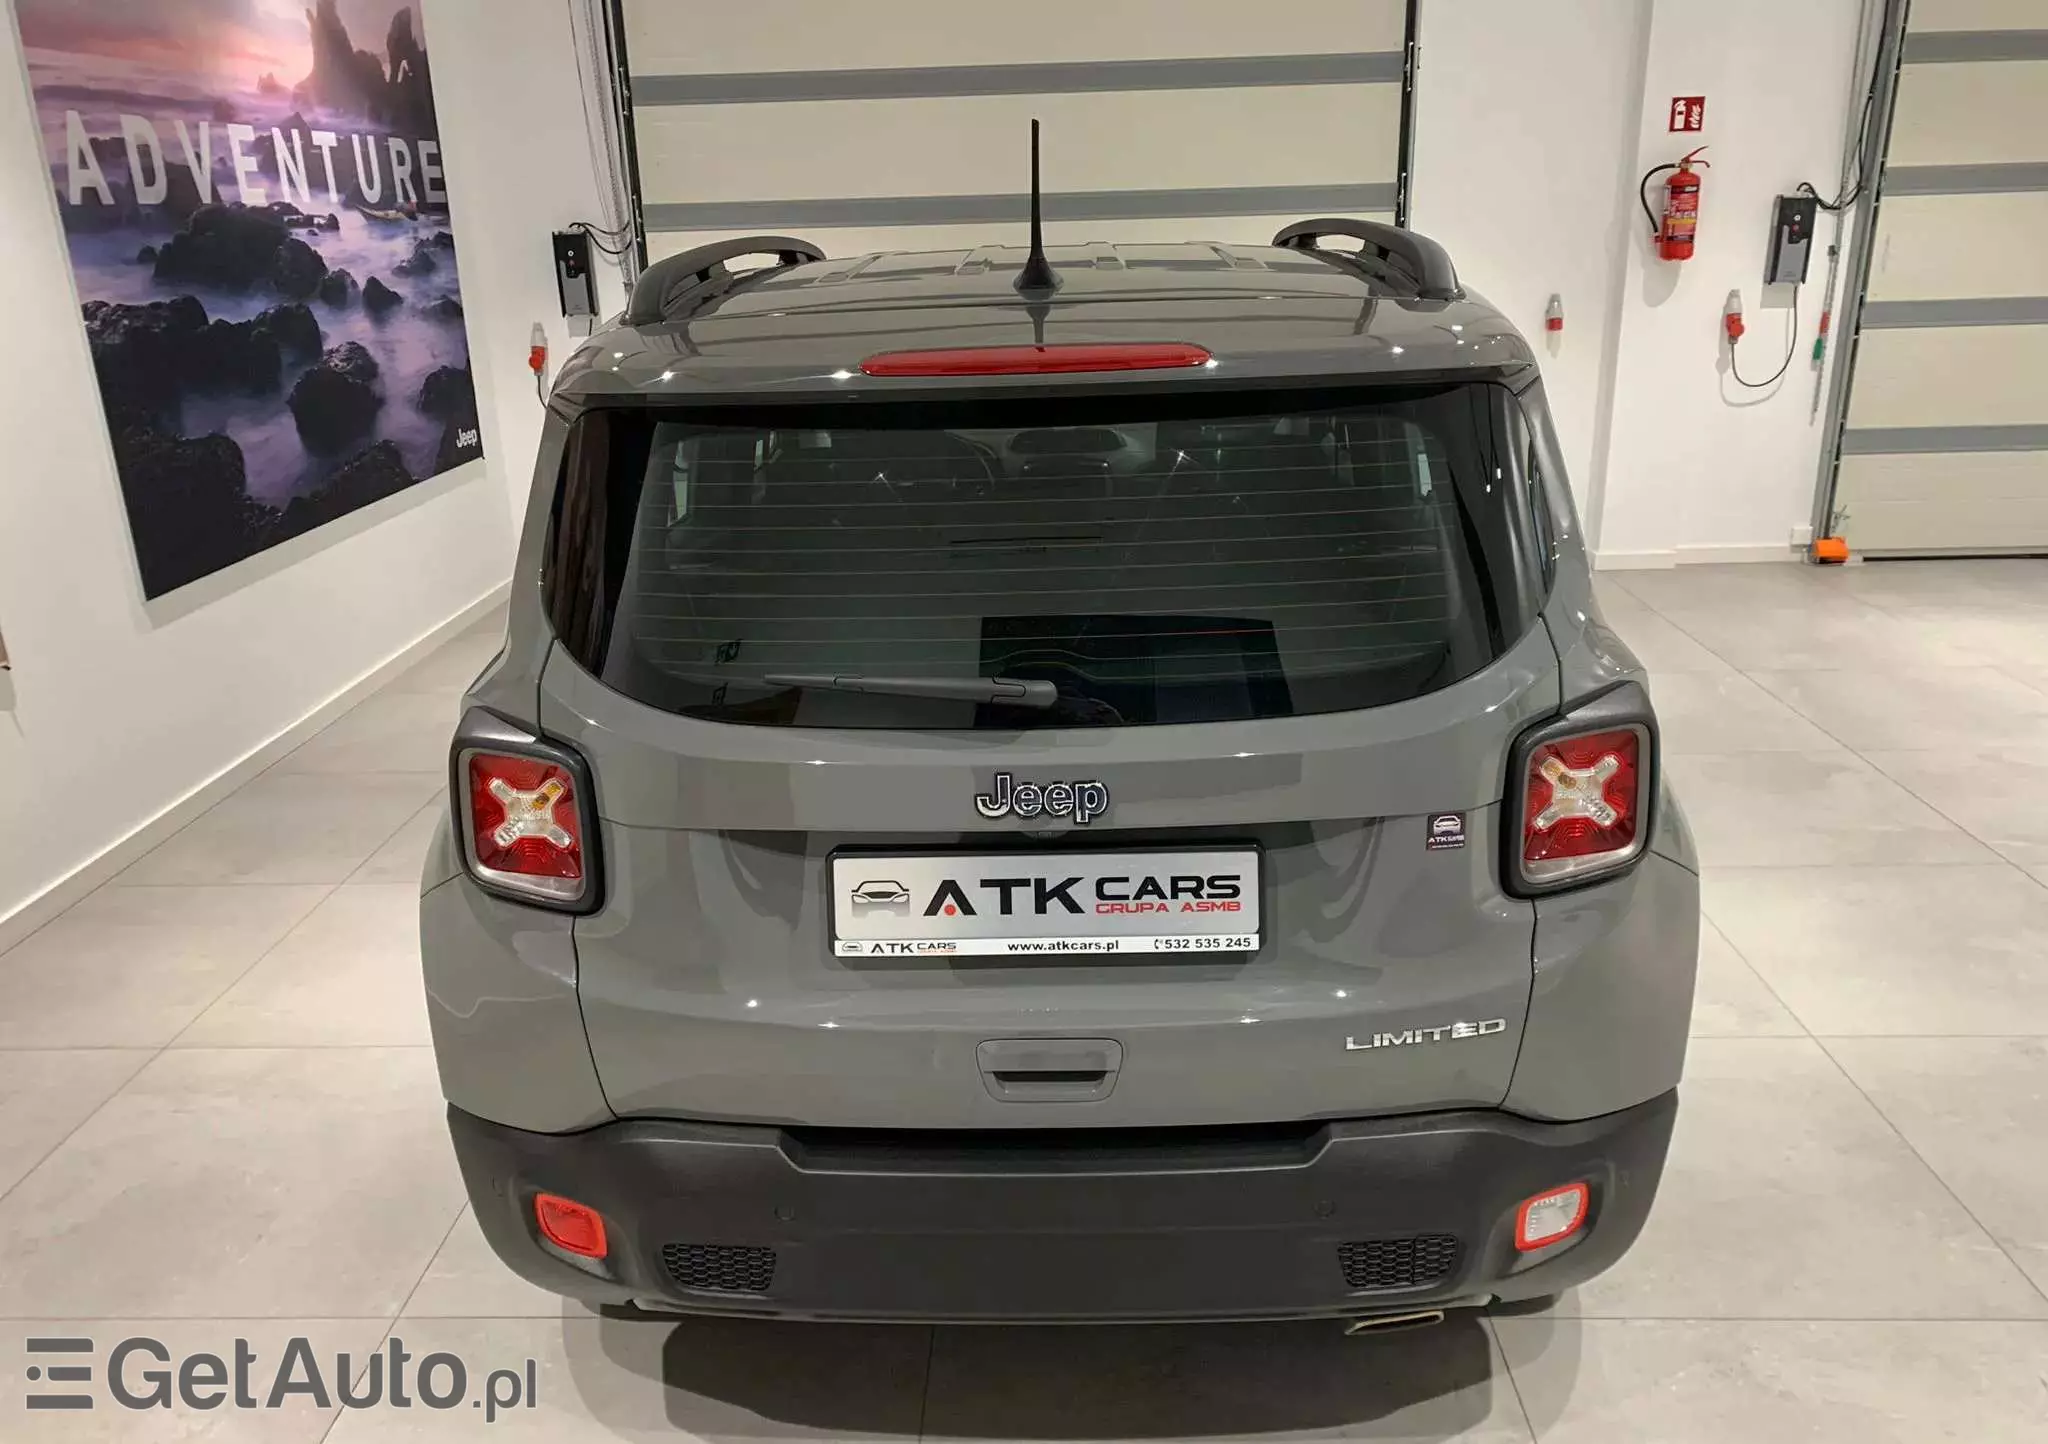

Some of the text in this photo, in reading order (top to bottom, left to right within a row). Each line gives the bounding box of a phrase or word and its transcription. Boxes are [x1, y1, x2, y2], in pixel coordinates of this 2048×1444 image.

[65, 109, 447, 206] ADVENTURE
[456, 427, 478, 448] Jeep
[976, 773, 1108, 824] Jeep
[923, 875, 1241, 916] ATK CARS
[1096, 901, 1242, 913] GRUPA ASMB
[870, 943, 914, 954] ATK
[916, 942, 957, 950] CARS
[1008, 940, 1120, 952] www.atkcars.pl
[1164, 937, 1252, 949] 532 535 245
[1345, 1018, 1506, 1051] LIMITED
